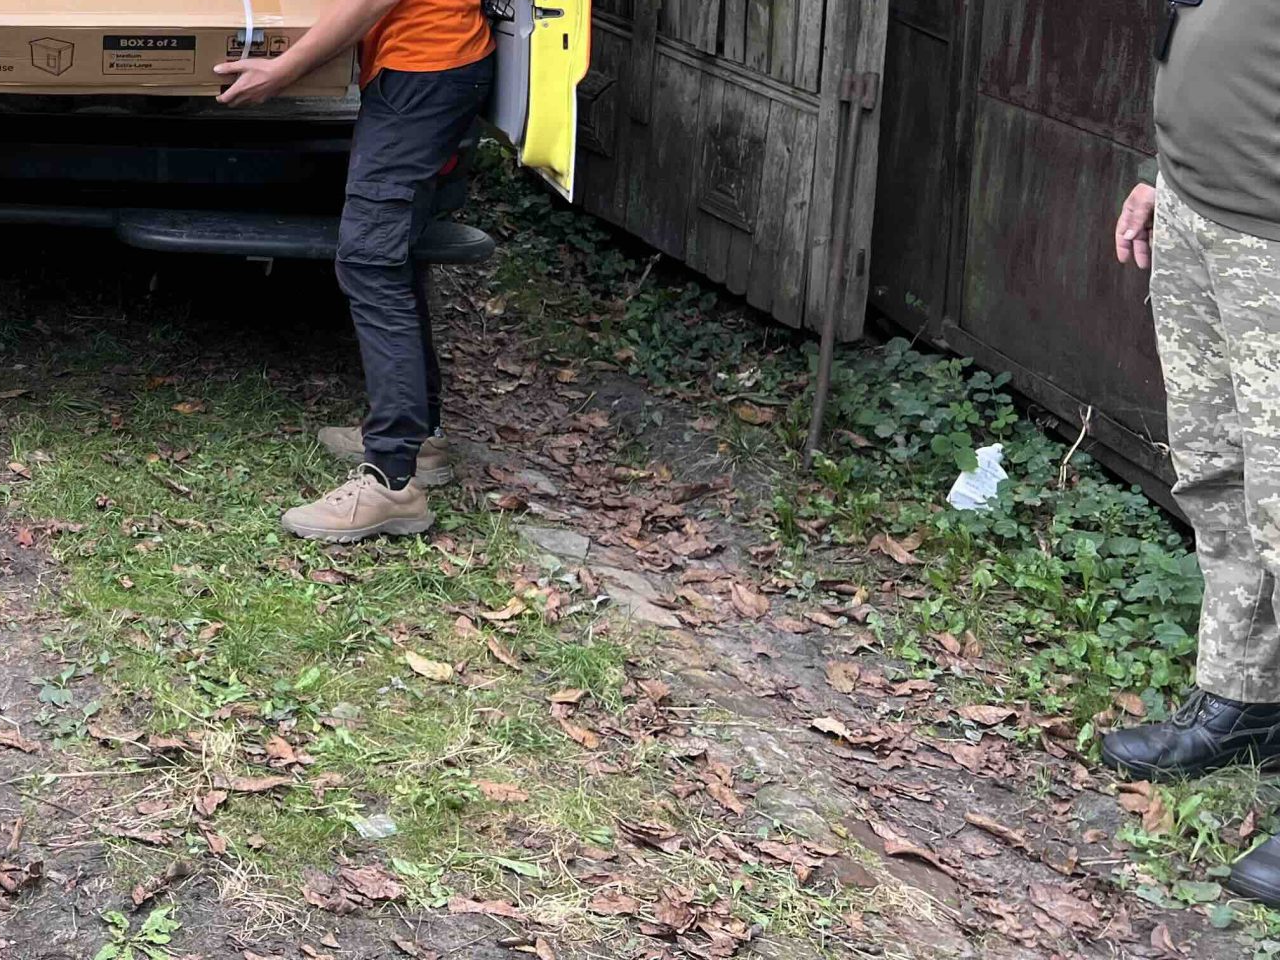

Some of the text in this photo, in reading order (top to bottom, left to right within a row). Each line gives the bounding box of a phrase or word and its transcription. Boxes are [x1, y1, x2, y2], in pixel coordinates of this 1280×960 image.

[120, 38, 177, 47] BOX 2 of 2
